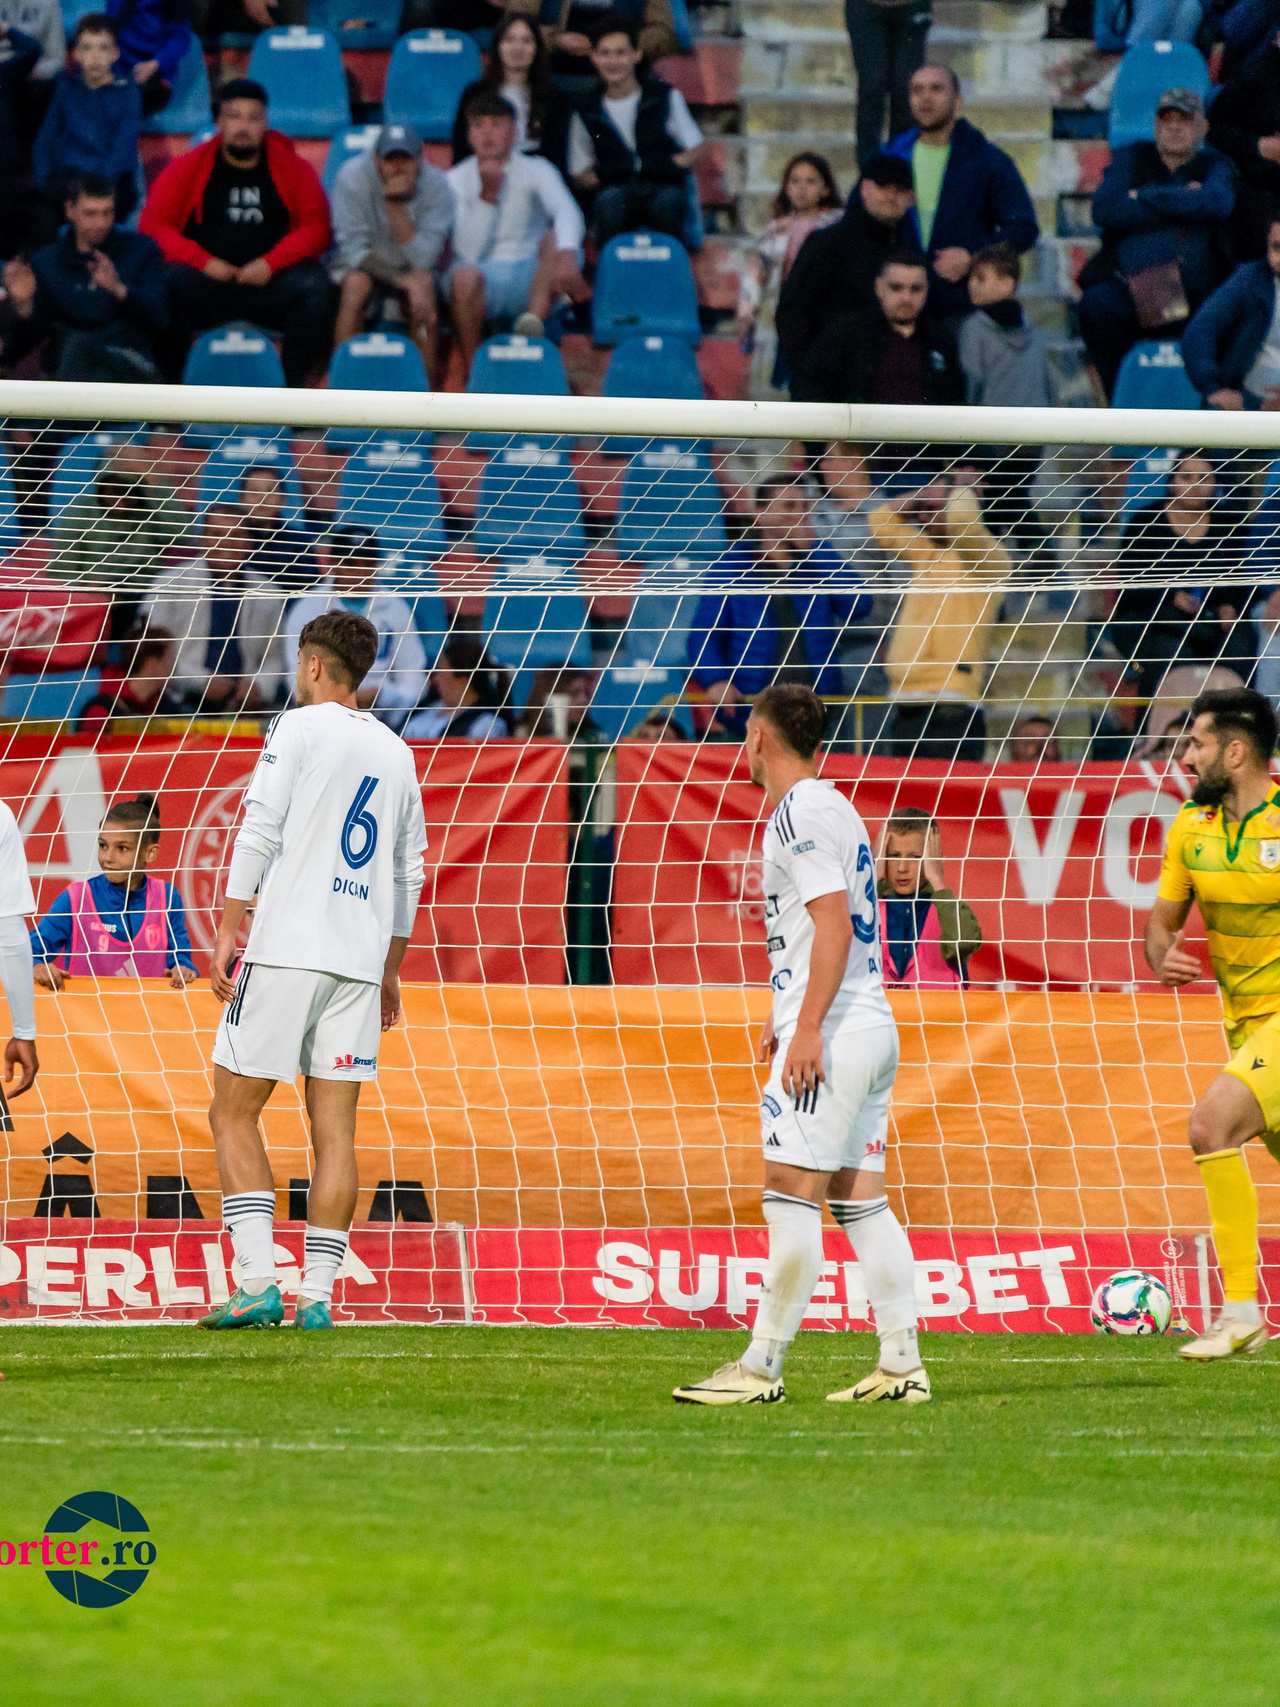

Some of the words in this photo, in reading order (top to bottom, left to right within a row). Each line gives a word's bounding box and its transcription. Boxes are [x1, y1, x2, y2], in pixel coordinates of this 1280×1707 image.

[230, 186, 261, 206] IN
[340, 775, 380, 870] 6
[333, 877, 369, 900] DICAN
